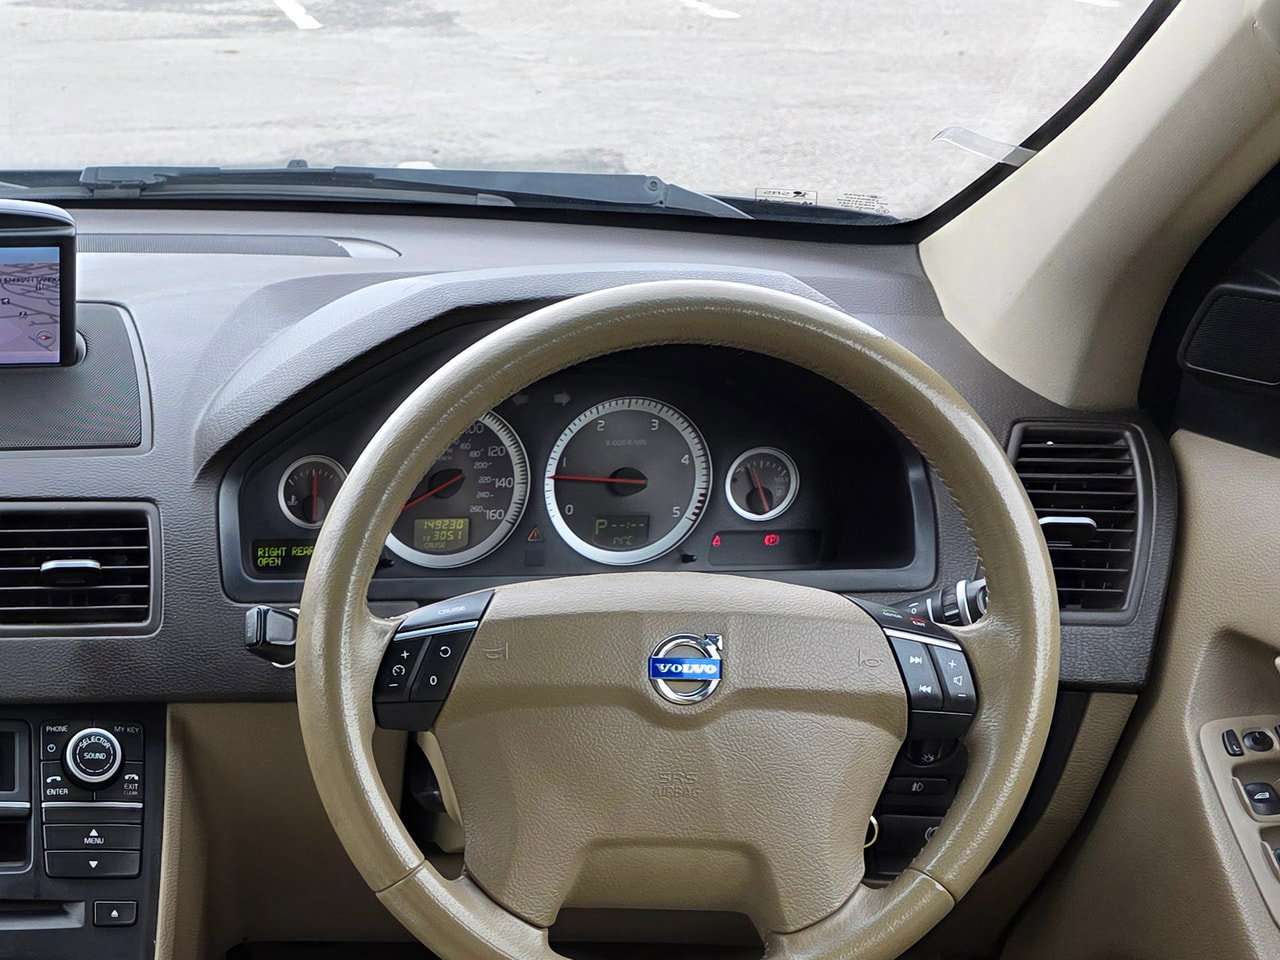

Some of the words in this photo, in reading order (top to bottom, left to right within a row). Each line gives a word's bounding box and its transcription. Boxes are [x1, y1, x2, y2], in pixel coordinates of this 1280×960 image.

[596, 420, 605, 431] 2
[651, 419, 659, 431] 3
[488, 446, 506, 457] 120
[681, 454, 689, 465] 4
[495, 477, 514, 488] 140
[487, 509, 505, 520] 160
[565, 504, 574, 516] 0
[672, 506, 681, 518] 5
[423, 519, 464, 530] 149230
[595, 519, 608, 535] P
[257, 547, 287, 557] RIGHT
[257, 557, 281, 567] OPEN
[654, 663, 718, 675] VOLVO
[46, 725, 68, 733] PHONE
[114, 725, 125, 733] MY
[127, 726, 140, 734] KEY
[79, 735, 111, 749] SELECTOR
[83, 752, 107, 760] SOUND
[46, 788, 69, 796] ENTER
[123, 783, 139, 791] EXIT
[83, 837, 105, 845] MENU
